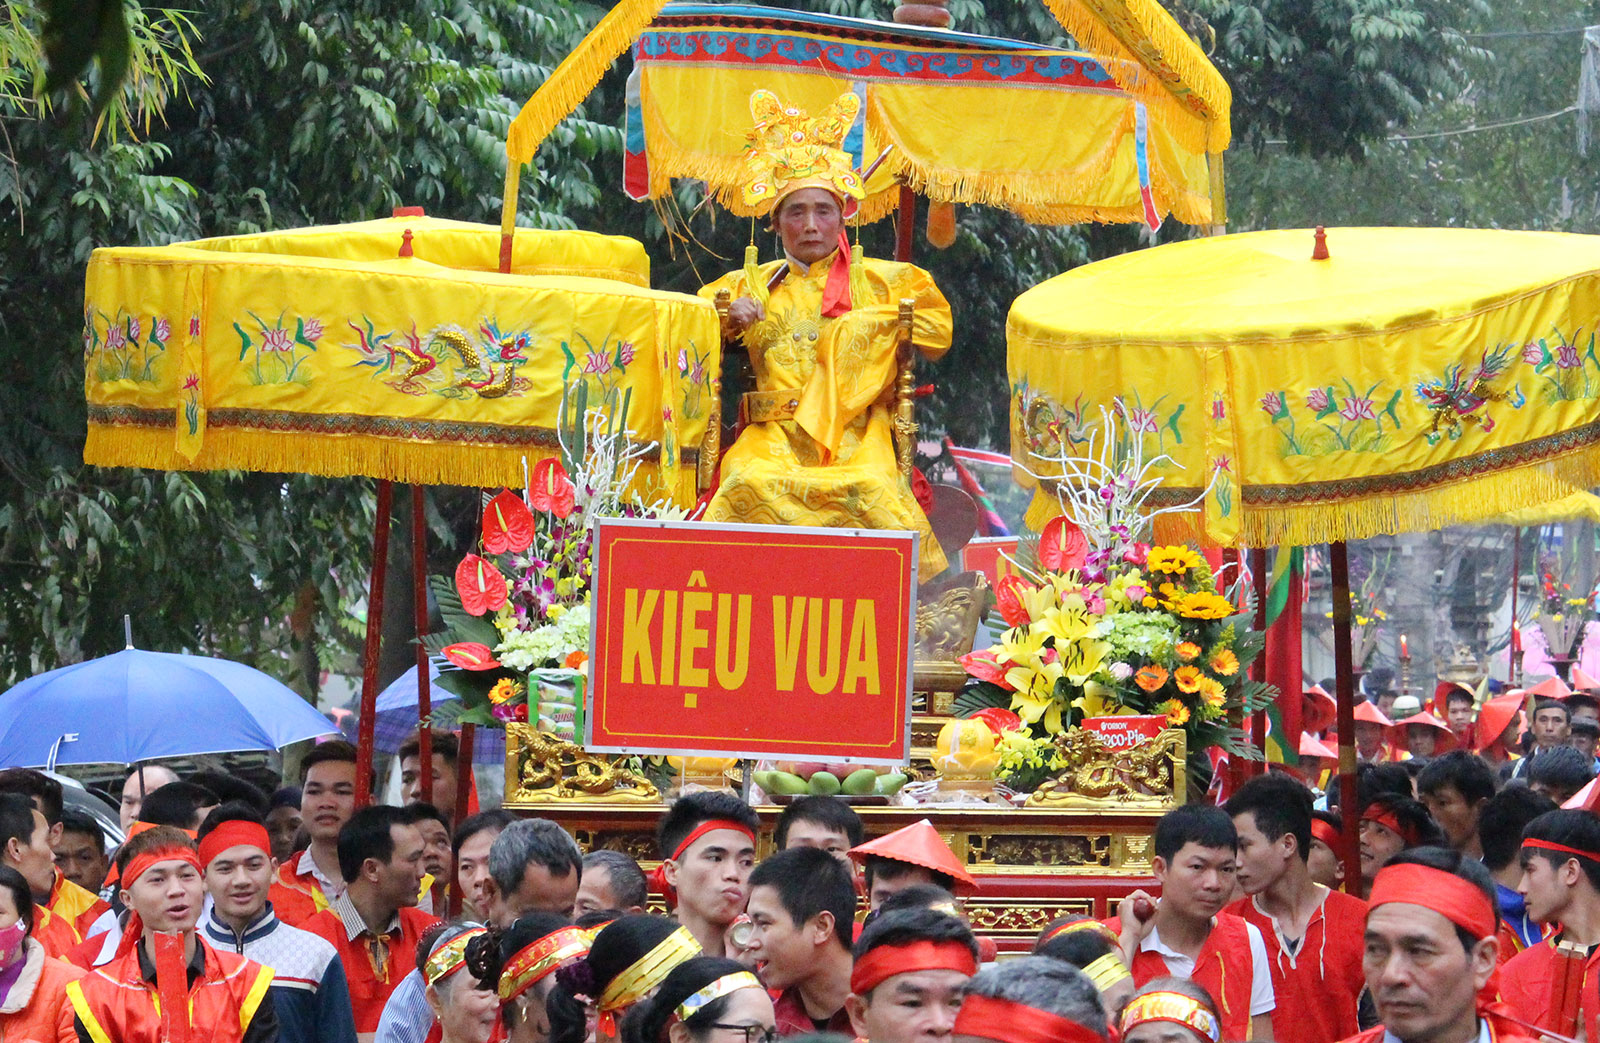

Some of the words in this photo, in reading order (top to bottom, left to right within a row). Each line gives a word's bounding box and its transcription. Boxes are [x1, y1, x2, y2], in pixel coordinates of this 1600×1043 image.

[620, 570, 752, 708] KIỆU
[772, 595, 881, 695] VUA
[1091, 729, 1146, 746] hoco-Pie
